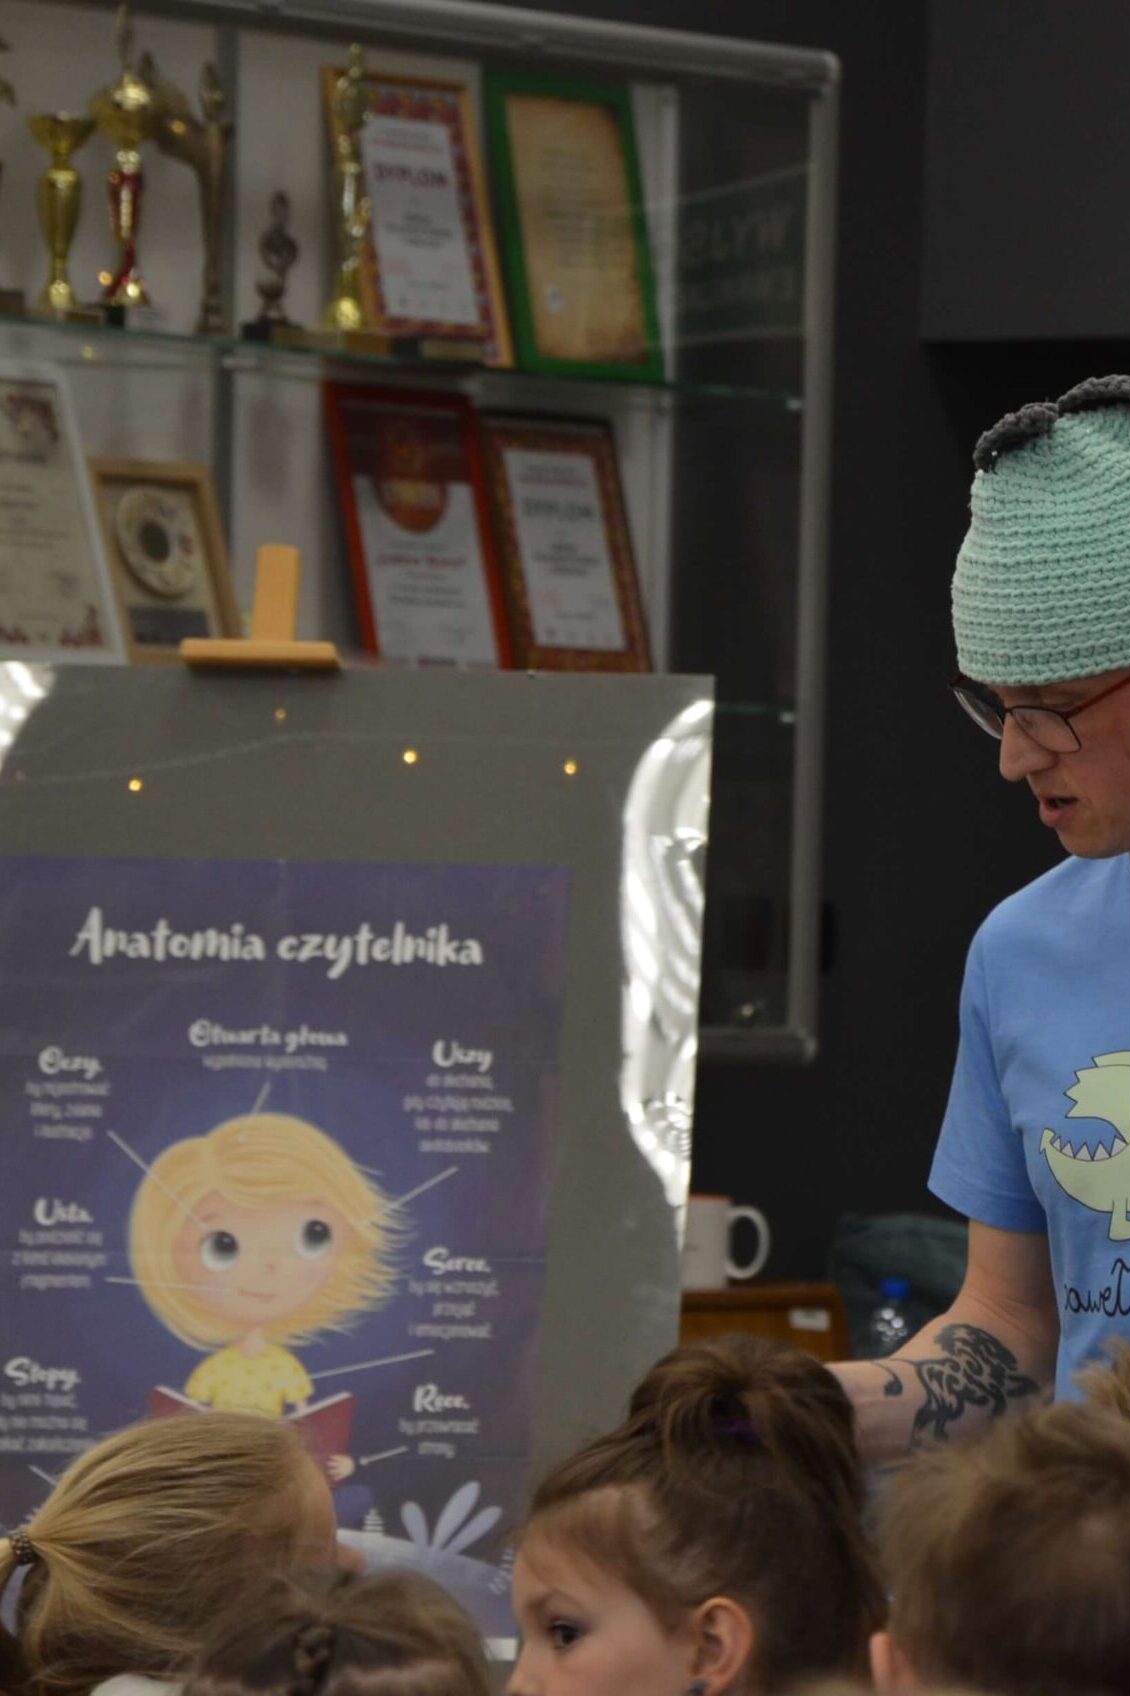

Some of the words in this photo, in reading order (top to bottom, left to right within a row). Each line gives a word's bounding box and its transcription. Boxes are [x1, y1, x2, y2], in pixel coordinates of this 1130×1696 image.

[68, 906, 266, 965] Anatomia
[276, 921, 484, 980] czytelnika
[432, 1039, 494, 1073] Uszy
